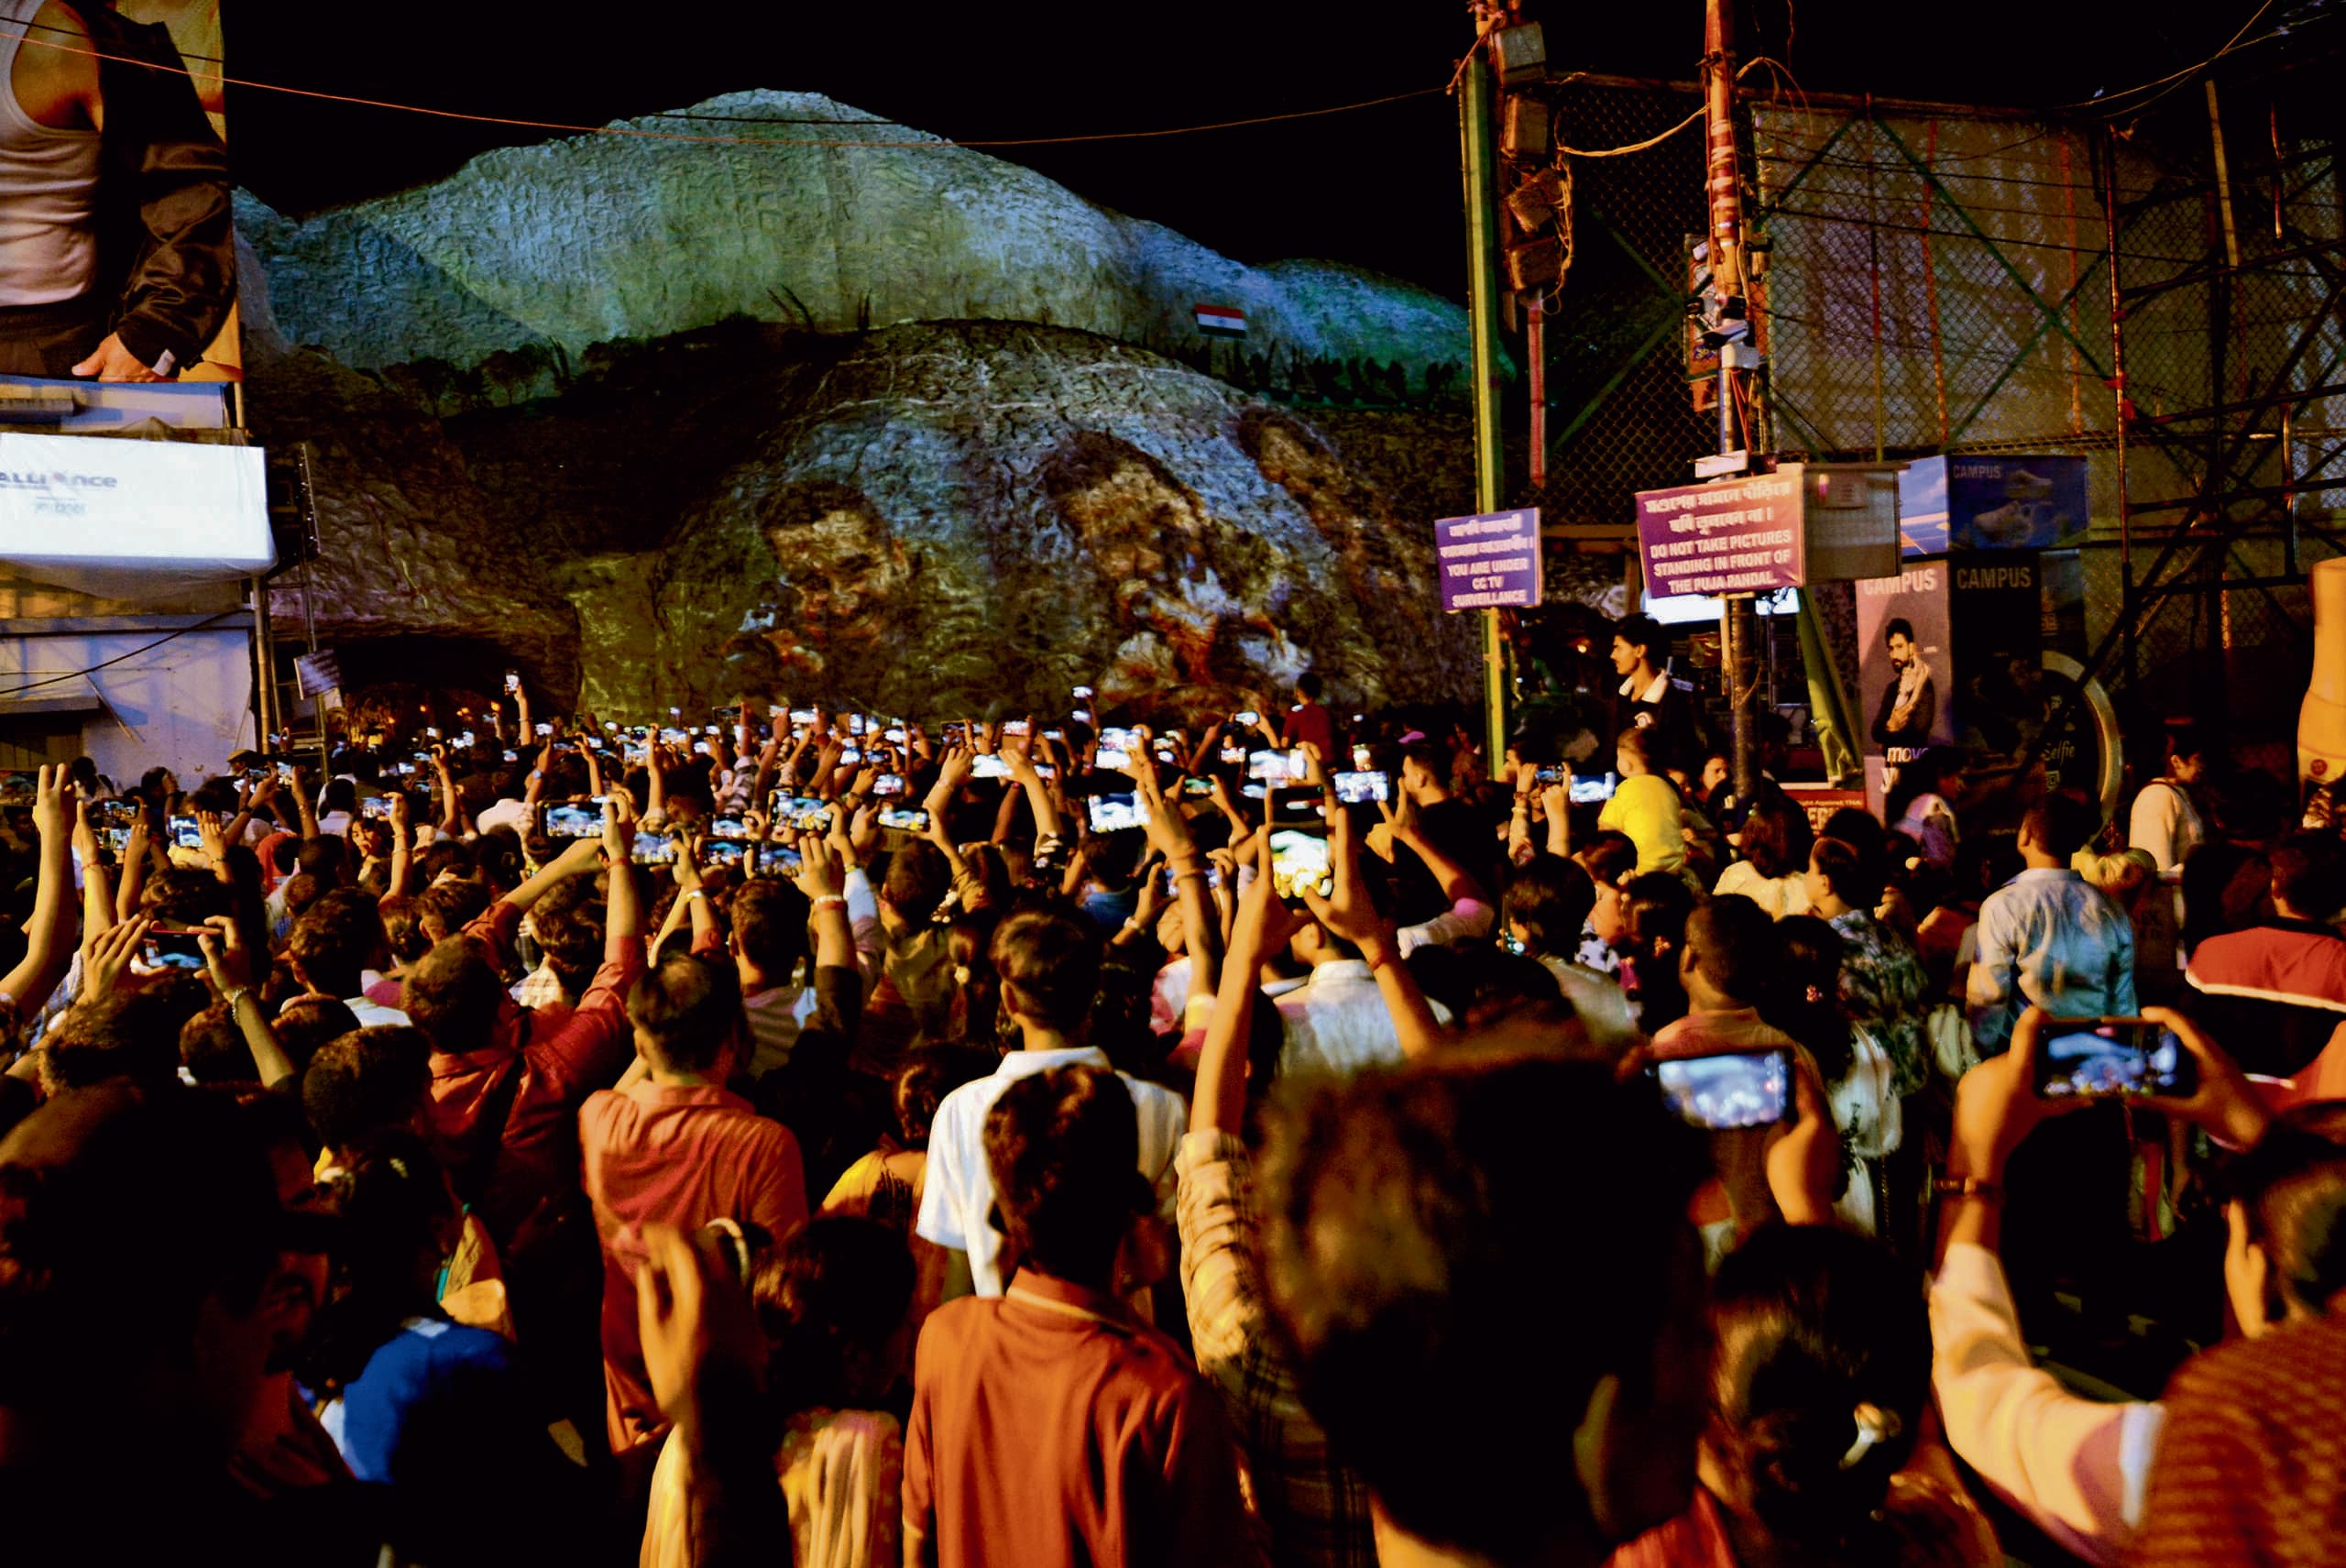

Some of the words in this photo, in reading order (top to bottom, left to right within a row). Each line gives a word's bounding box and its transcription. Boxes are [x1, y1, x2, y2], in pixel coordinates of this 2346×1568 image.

[1953, 465, 2001, 478] CAMPUS
[1650, 545, 1668, 559] DO
[1670, 541, 1694, 556] NOT
[1695, 537, 1729, 554] TAKE
[1730, 530, 1792, 550] PICTURES
[1447, 564, 1469, 577] YOU
[1470, 561, 1491, 576] ARE
[1492, 557, 1529, 573] UNDER
[1653, 558, 1712, 577] STANDING
[1715, 556, 1727, 570] IN
[1730, 552, 1772, 568] FRONT
[1774, 550, 1791, 564] OF
[1668, 579, 1692, 594] THE
[1694, 576, 1726, 592] PUJA
[1727, 571, 1778, 589] PANDAL.
[1863, 568, 1937, 595] CAMPUS
[1957, 566, 2032, 589] CAMPUS
[1452, 589, 1528, 608] SURVEILLANCE
